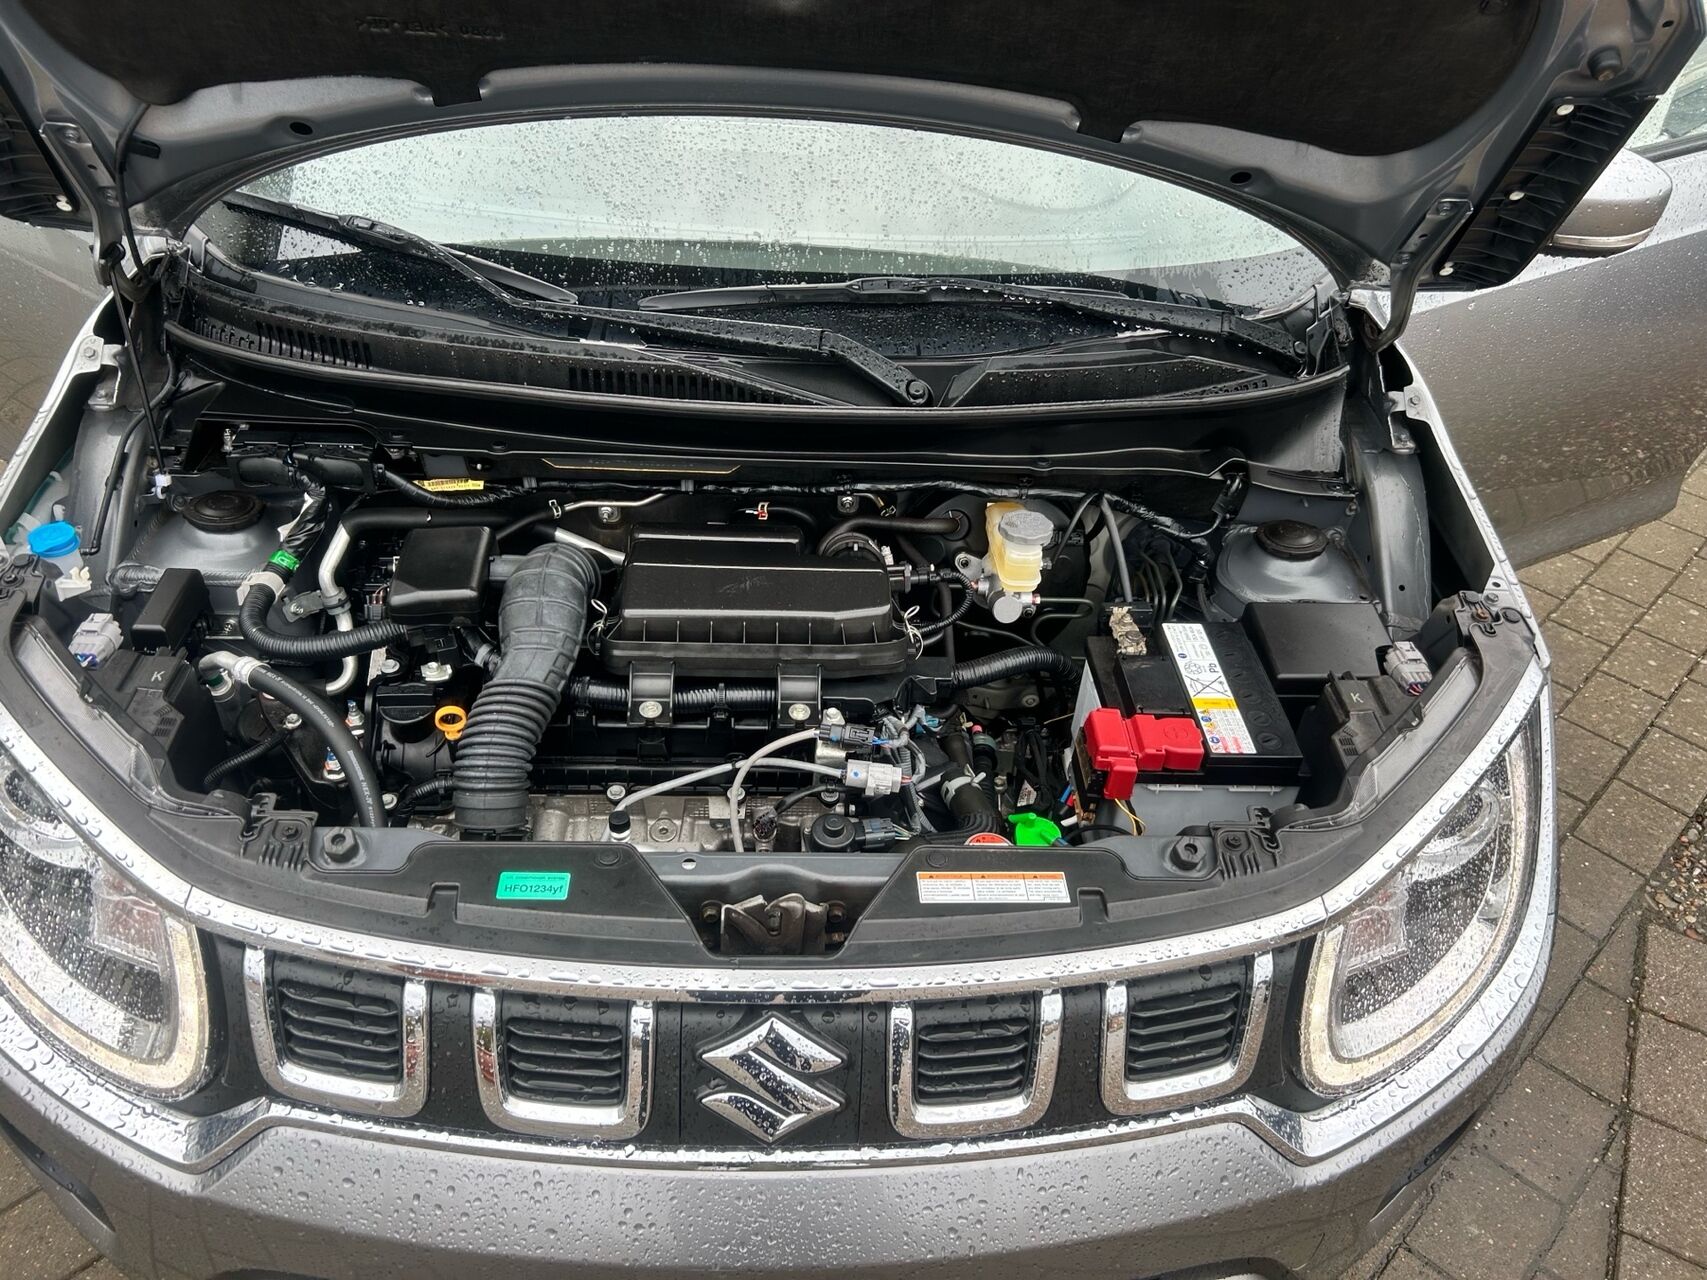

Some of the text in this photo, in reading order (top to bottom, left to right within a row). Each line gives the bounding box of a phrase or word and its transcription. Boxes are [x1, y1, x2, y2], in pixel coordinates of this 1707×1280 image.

[1208, 662, 1219, 673] Pb
[150, 670, 166, 682] K
[1350, 692, 1364, 703] K
[503, 883, 564, 895] HFO1234yf
